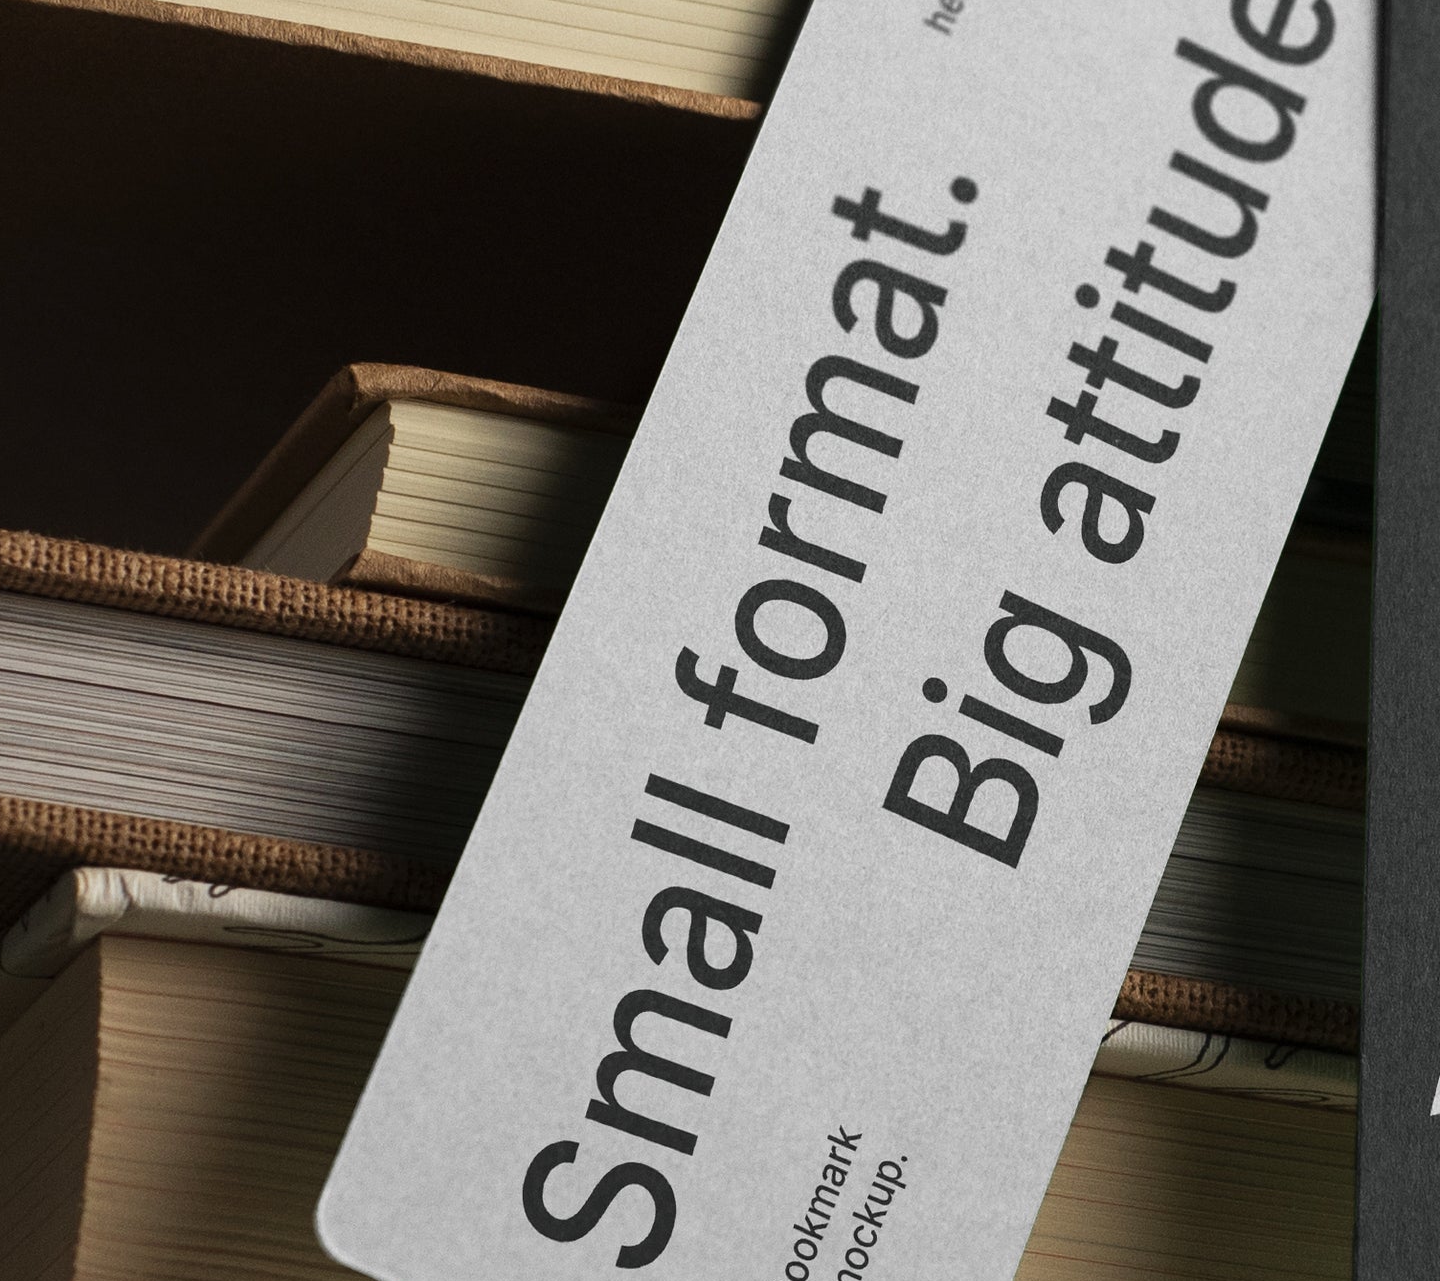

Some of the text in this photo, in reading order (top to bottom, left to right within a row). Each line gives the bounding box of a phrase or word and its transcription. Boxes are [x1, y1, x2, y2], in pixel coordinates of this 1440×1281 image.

[521, 175, 979, 1271] Small format.
[882, 590, 1134, 869] Big
